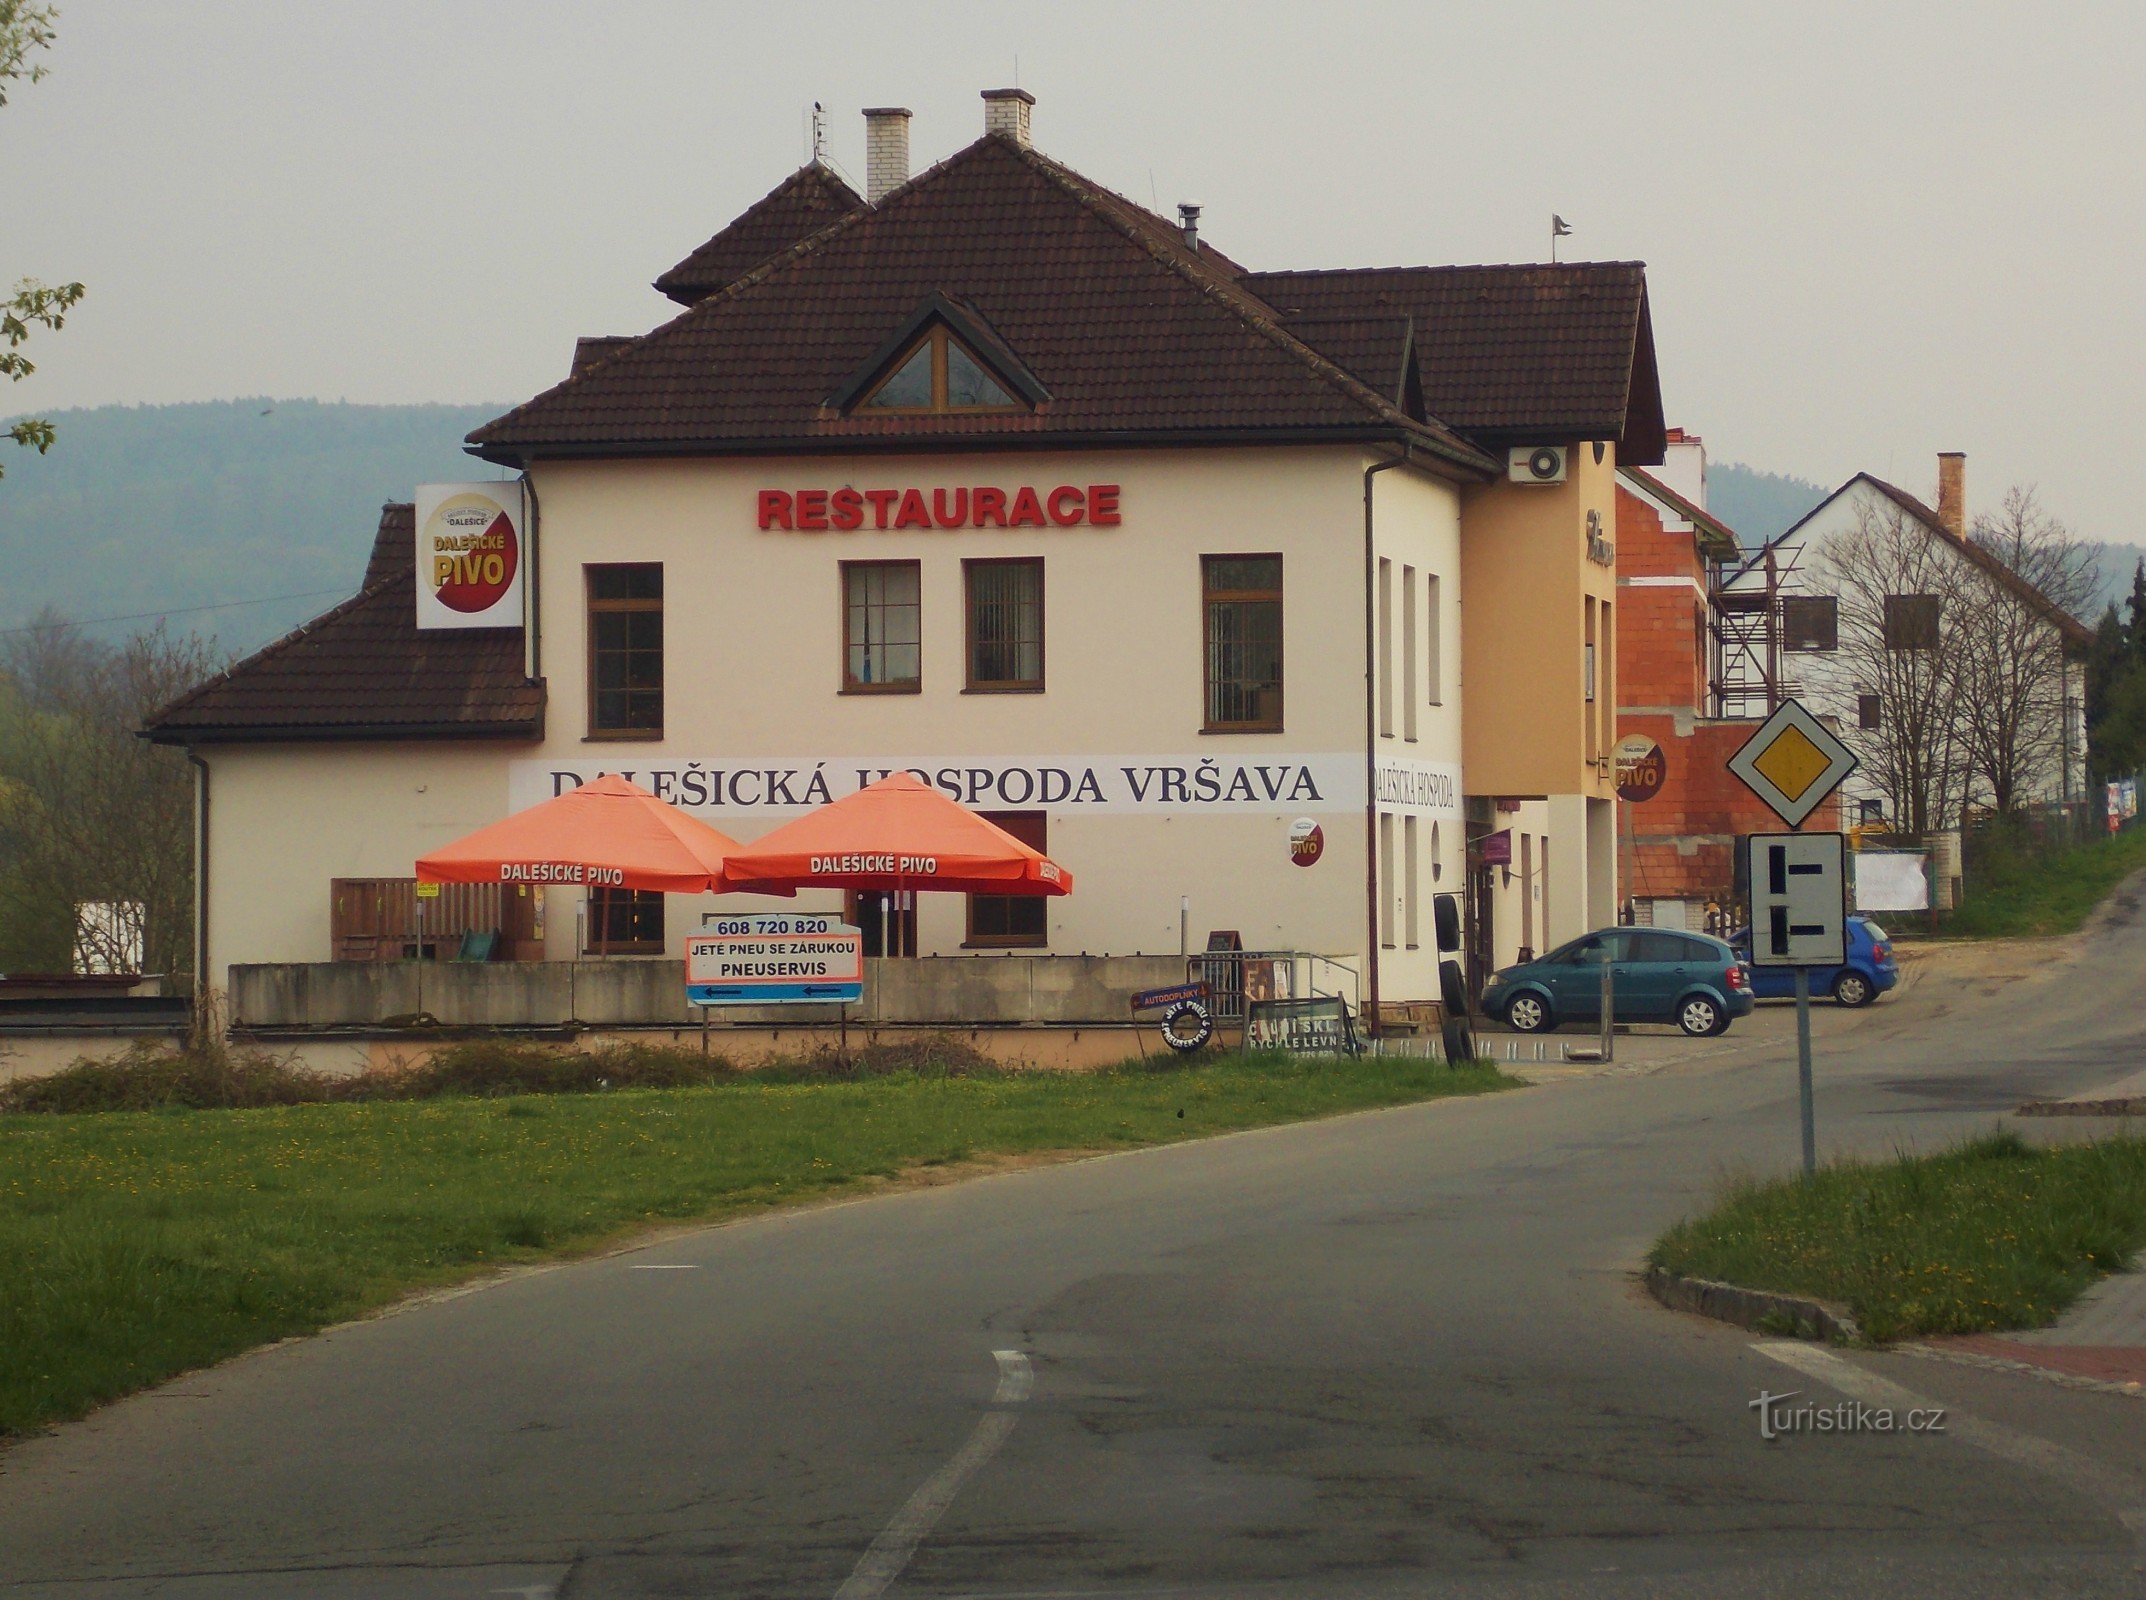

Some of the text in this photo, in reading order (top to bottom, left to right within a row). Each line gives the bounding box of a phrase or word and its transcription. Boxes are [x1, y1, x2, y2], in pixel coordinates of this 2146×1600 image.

[758, 484, 1121, 529] RESTAURACE
[433, 533, 504, 551] DALEŠICKÉ
[433, 553, 504, 587] PIVO
[551, 762, 835, 806] DEŠICKÁ
[1120, 758, 1324, 802] VRŠAVA
[1616, 768, 1658, 787] PIVO
[1417, 771, 1454, 808] HOSPODA
[1290, 842, 1318, 854] PIVO
[811, 852, 937, 874] DALEŠICKÉ PIVO
[501, 861, 623, 885] DALEŠICKÉ PIVO
[717, 920, 828, 935] 608 720 820
[692, 941, 855, 956] JETÉ PNEU SE ZÁRUKOU
[721, 962, 827, 976] PNEUSERVIS
[1186, 1000, 1208, 1019] PNEU
